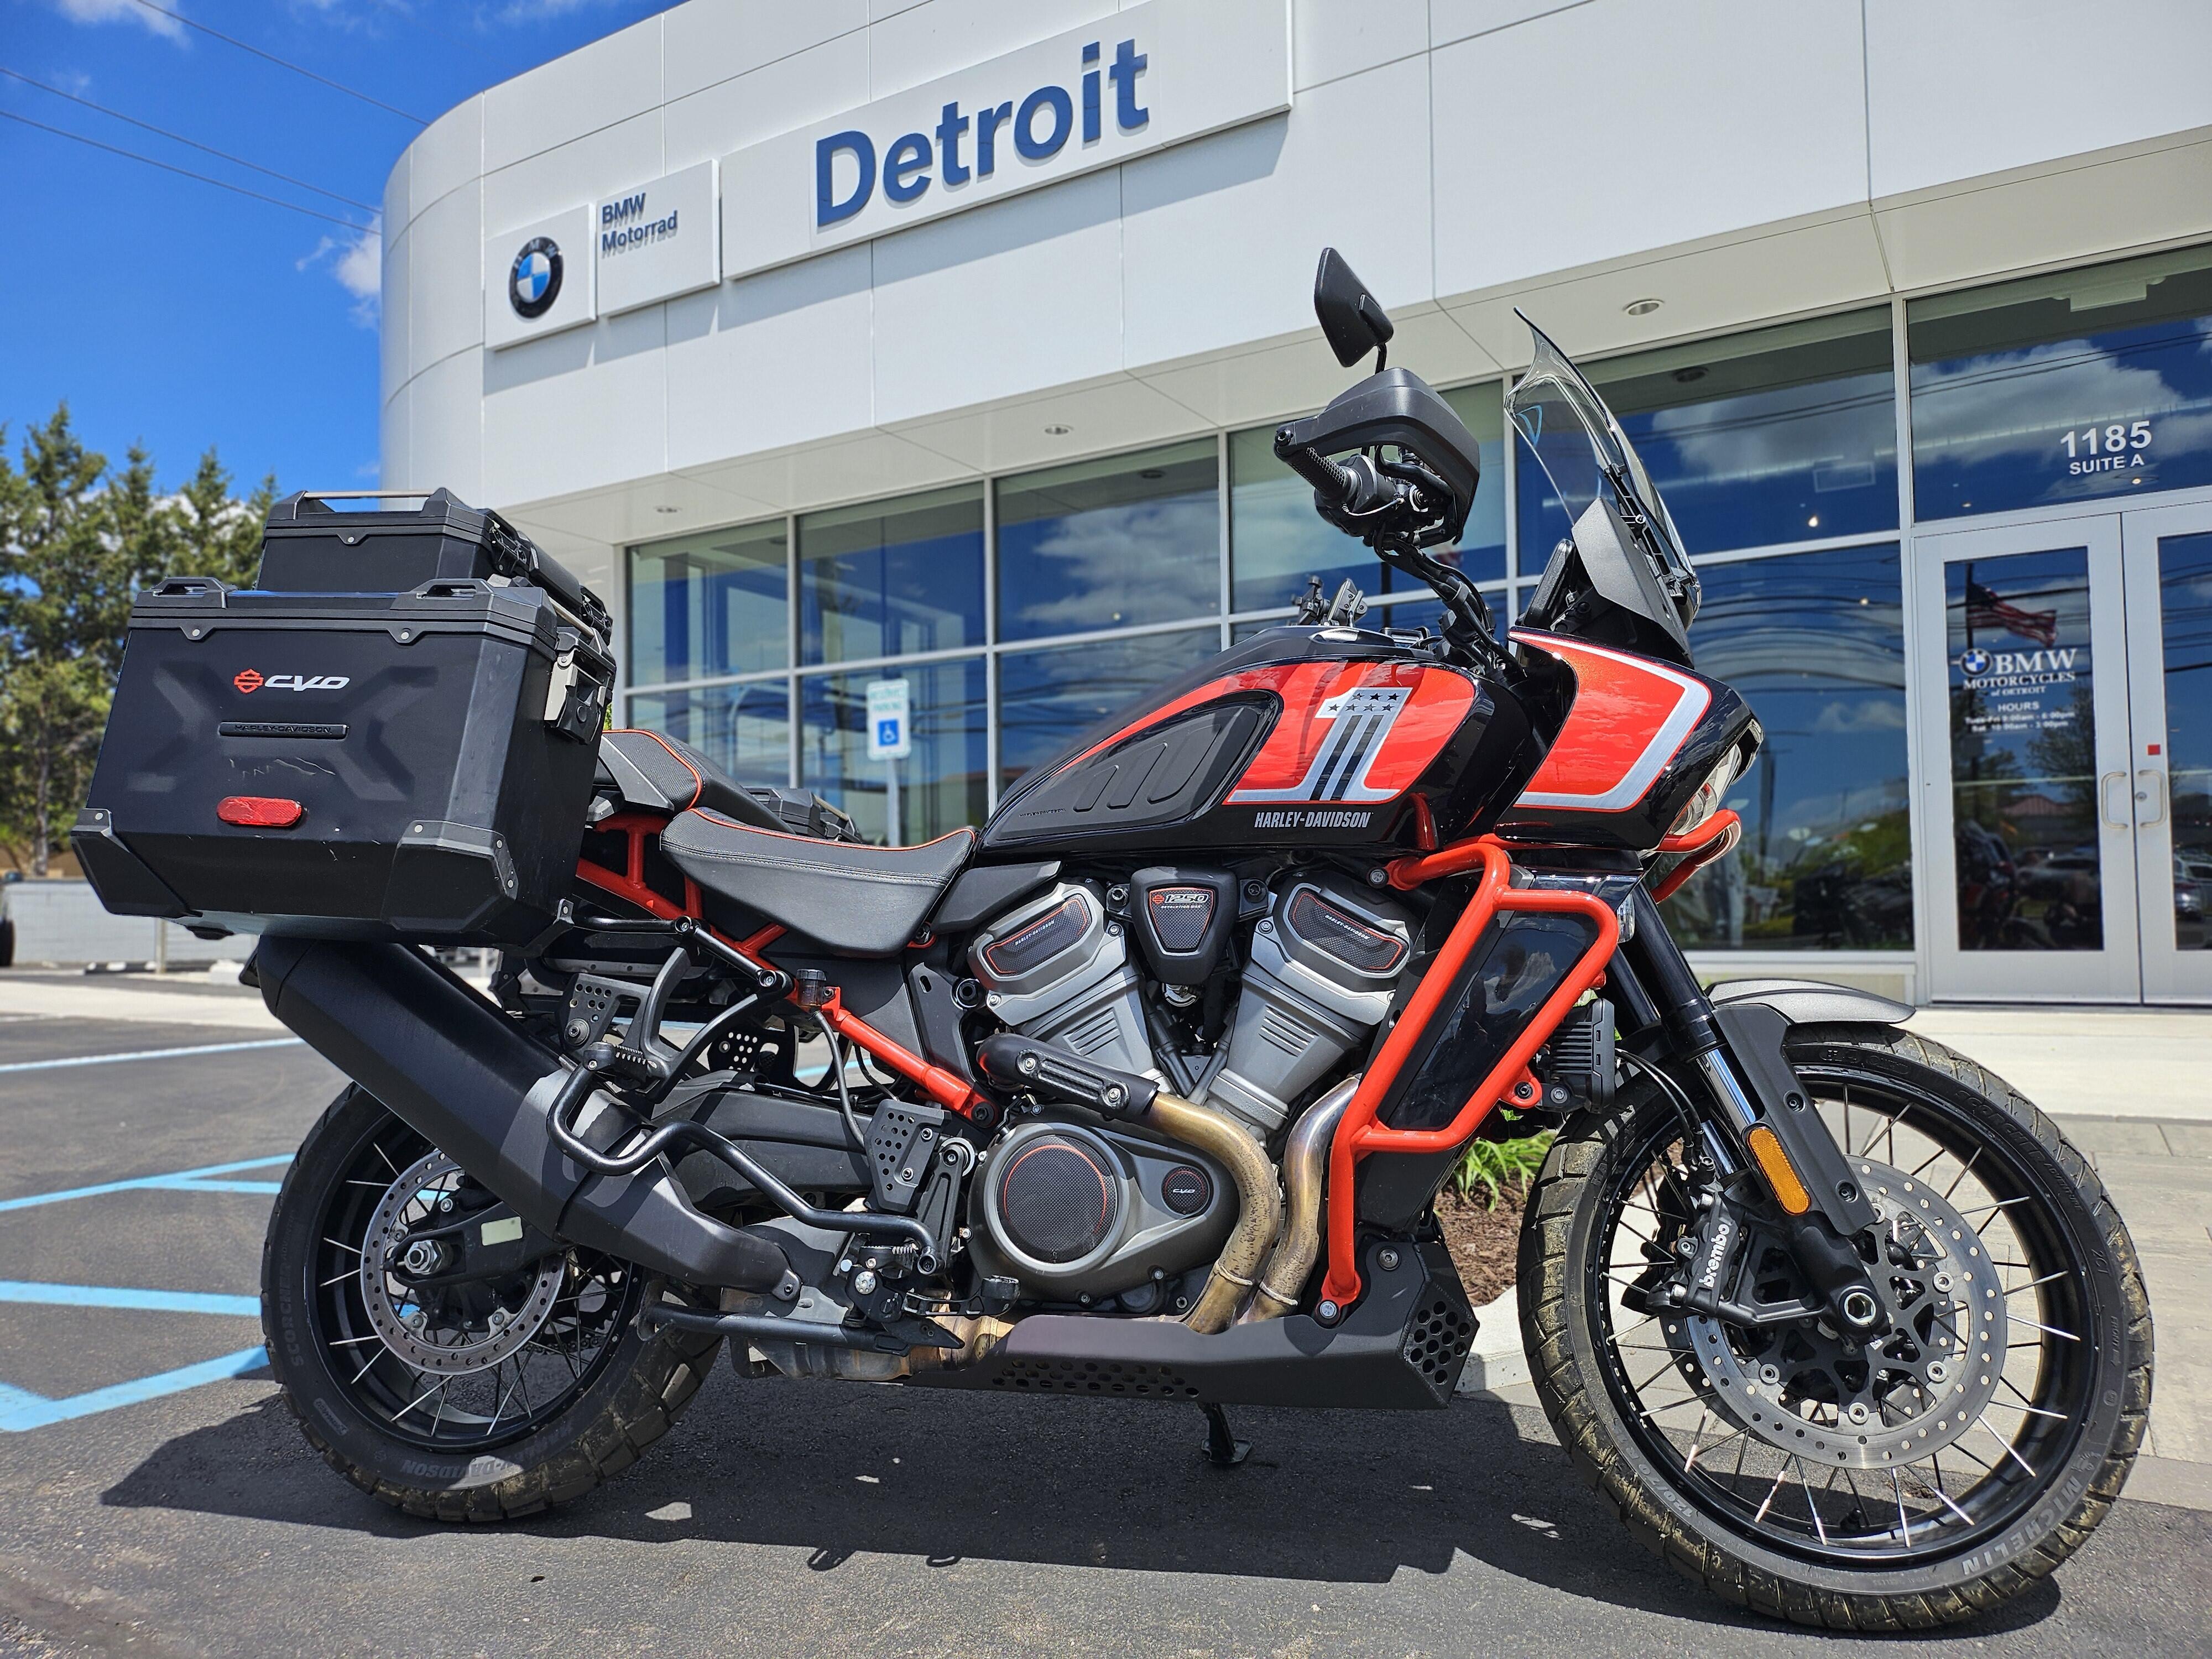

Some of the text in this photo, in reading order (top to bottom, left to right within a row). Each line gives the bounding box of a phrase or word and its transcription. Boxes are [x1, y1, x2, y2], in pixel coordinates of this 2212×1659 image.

[815, 38, 1150, 227] Detroit
[602, 192, 646, 225] BMW
[602, 210, 678, 252] Motorrad
[2060, 420, 2152, 458] 1185
[2069, 453, 2145, 475] SUITE A
[1994, 648, 2078, 675] BMW
[264, 675, 350, 691] CVO
[1964, 671, 2076, 690] MOTORCYCLES
[1997, 701, 2040, 712] HOURS
[234, 724, 332, 734] HARLEY-DAVIDSON
[1254, 812, 1371, 828] HARLEY-DAVIDSON
[1165, 894, 1209, 903] 1250
[1015, 920, 1055, 946] HARLEY-DAVIDSON
[1325, 915, 1370, 940] HARLEY-DAVIDSON
[1698, 1224, 1730, 1288] brembo
[1962, 1477, 2083, 1575] MICHELIN
